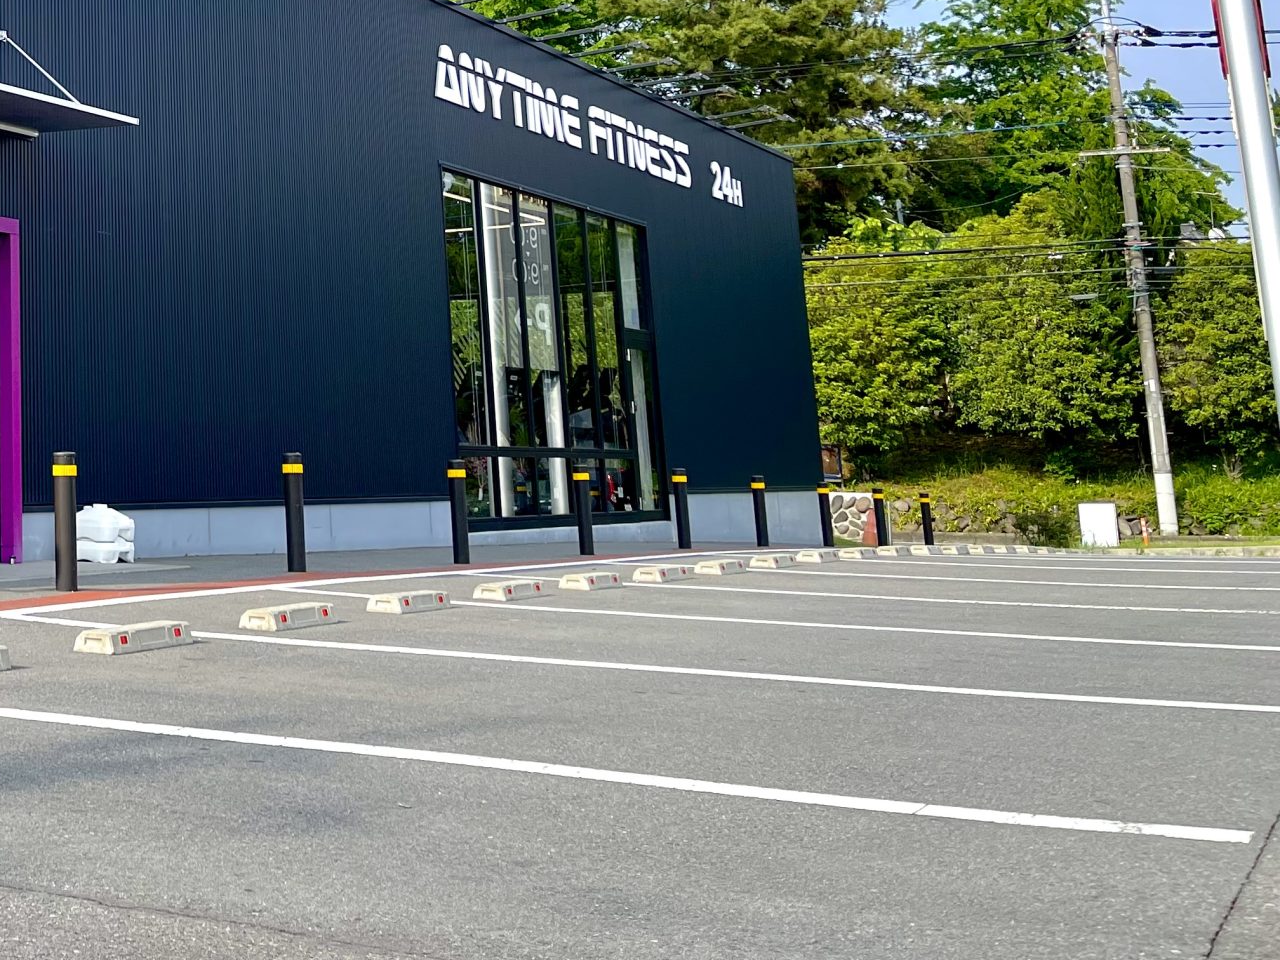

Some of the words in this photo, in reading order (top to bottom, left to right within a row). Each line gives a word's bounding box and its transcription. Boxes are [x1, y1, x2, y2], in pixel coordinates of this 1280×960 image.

[434, 44, 582, 149] ANYTIME
[587, 105, 691, 188] FITNESS
[709, 161, 744, 207] 24H
